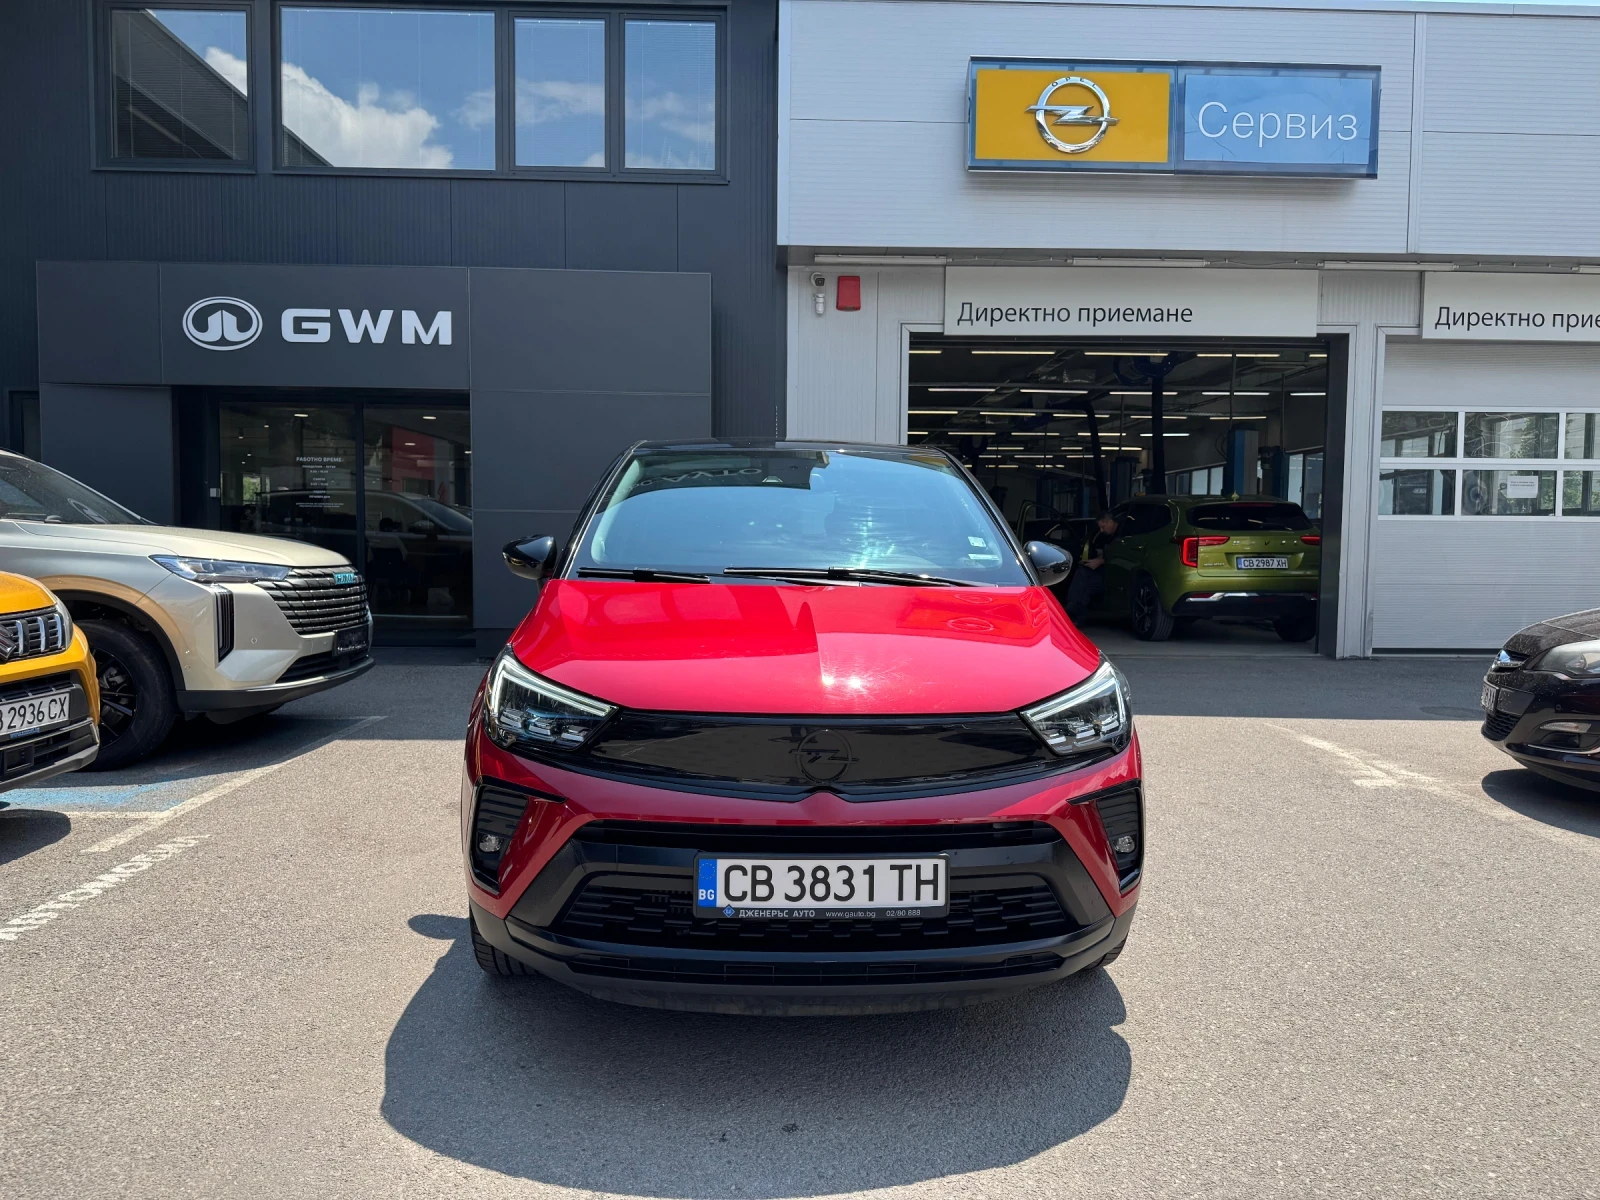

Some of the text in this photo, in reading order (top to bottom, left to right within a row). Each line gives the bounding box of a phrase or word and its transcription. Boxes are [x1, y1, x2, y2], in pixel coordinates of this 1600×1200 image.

[1051, 76, 1097, 89] OPEL
[1198, 101, 1358, 148] Сервиз
[281, 308, 452, 345] GWM
[957, 302, 1193, 327] Директно приемане
[1434, 306, 1546, 331] Директно
[1243, 559, 1255, 568] CB
[1256, 559, 1275, 568] 2987
[1276, 559, 1288, 568] XH
[8, 701, 45, 729] 2936
[48, 696, 67, 720] CX
[698, 863, 939, 902] BG CB 3831 TH
[792, 909, 816, 918] АУТО
[825, 910, 876, 919] www.gauto.bg
